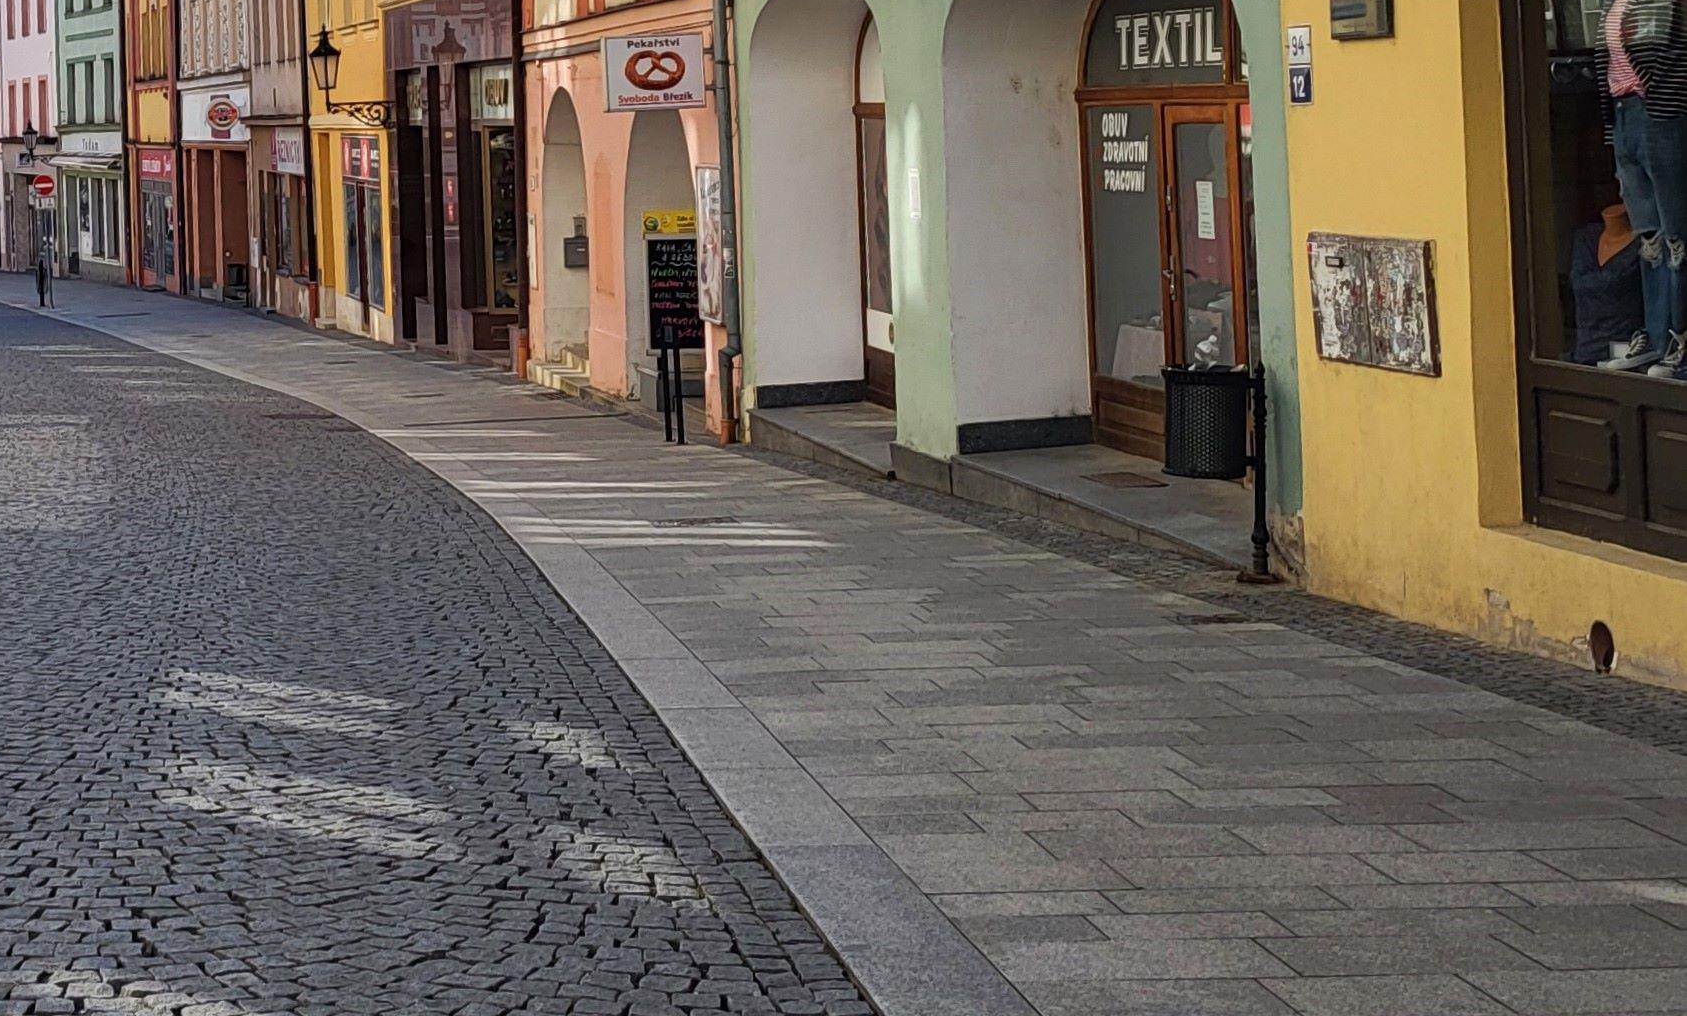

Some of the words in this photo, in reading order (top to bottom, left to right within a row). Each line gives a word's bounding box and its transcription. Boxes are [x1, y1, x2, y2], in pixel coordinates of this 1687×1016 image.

[1115, 6, 1223, 70] TEXTIL
[1291, 35, 1304, 56] 94
[618, 93, 660, 103] Svoboda
[1292, 75, 1306, 98] 12
[1101, 113, 1128, 137] OBUV
[1103, 135, 1149, 163] ZDRAVOTNÍ
[1104, 166, 1146, 192] PRACOVNÍ
